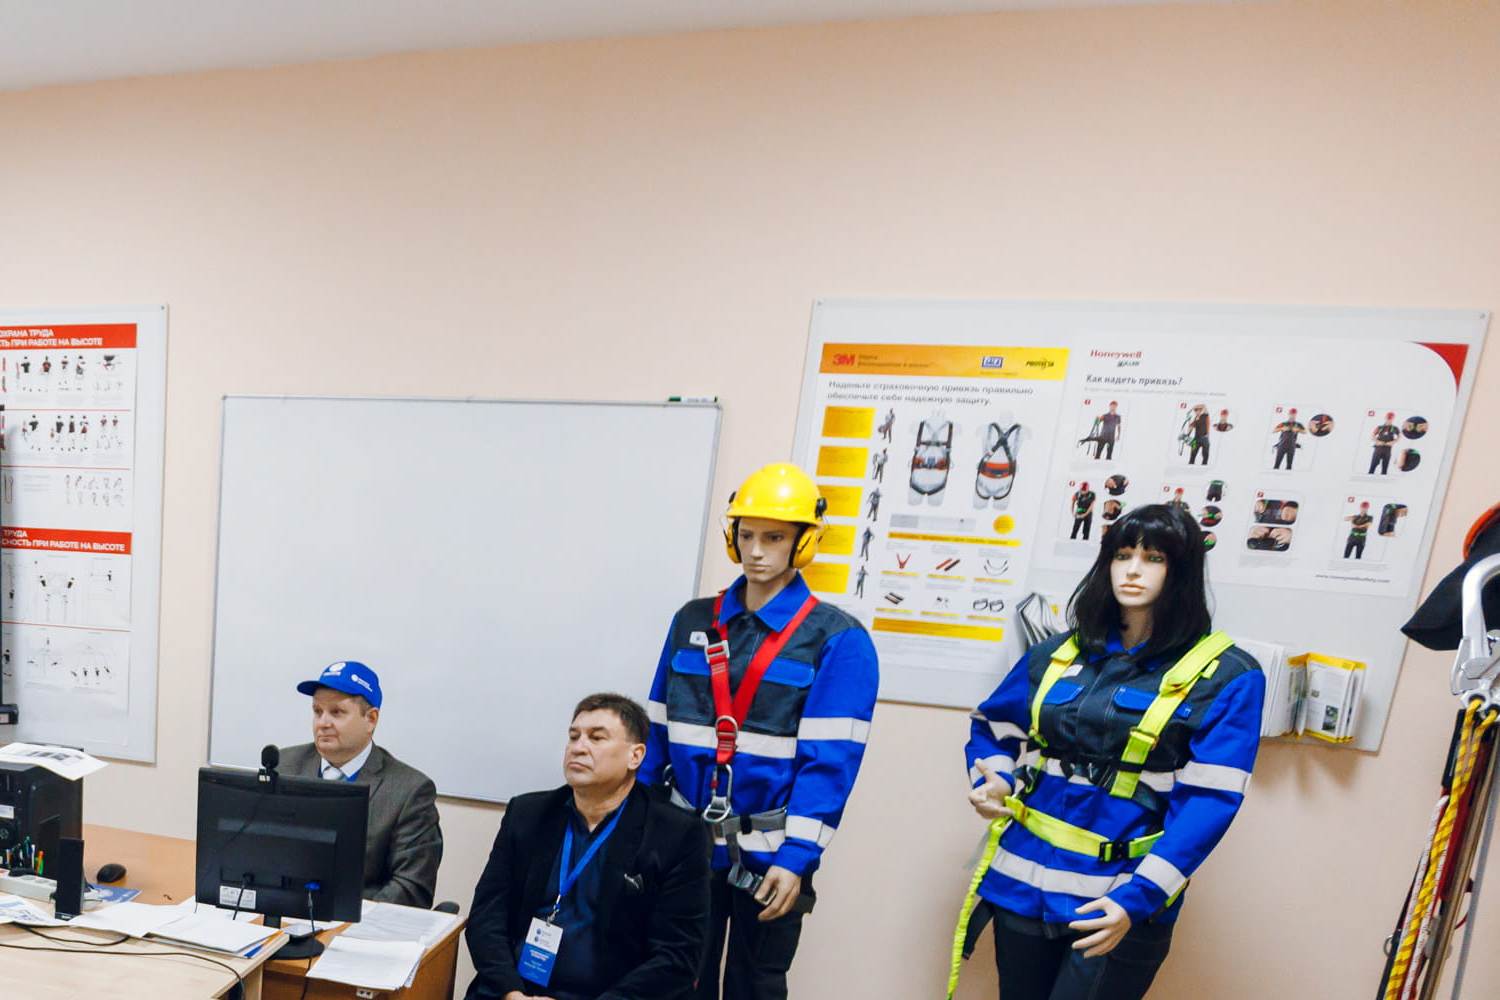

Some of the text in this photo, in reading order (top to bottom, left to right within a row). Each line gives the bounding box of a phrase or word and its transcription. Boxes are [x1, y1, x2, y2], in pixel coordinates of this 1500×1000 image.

[29, 329, 54, 337] ТРУДА
[11, 339, 27, 347] ПРИ
[28, 338, 57, 347] РАБОТЕ
[58, 338, 70, 346] НА
[71, 337, 103, 346] ВЫСОТЕ
[1090, 350, 1142, 358] Honeywell
[832, 353, 856, 366] 3M
[1086, 374, 1102, 383] Как
[1104, 377, 1137, 385] надеть
[829, 381, 872, 390] Наденьте
[4, 529, 28, 538] ТРУДА
[32, 539, 49, 547] ПРИ
[50, 540, 79, 549] РАБОТЕ
[80, 542, 92, 550] НА
[93, 542, 125, 551] ВЫСОТЕ
